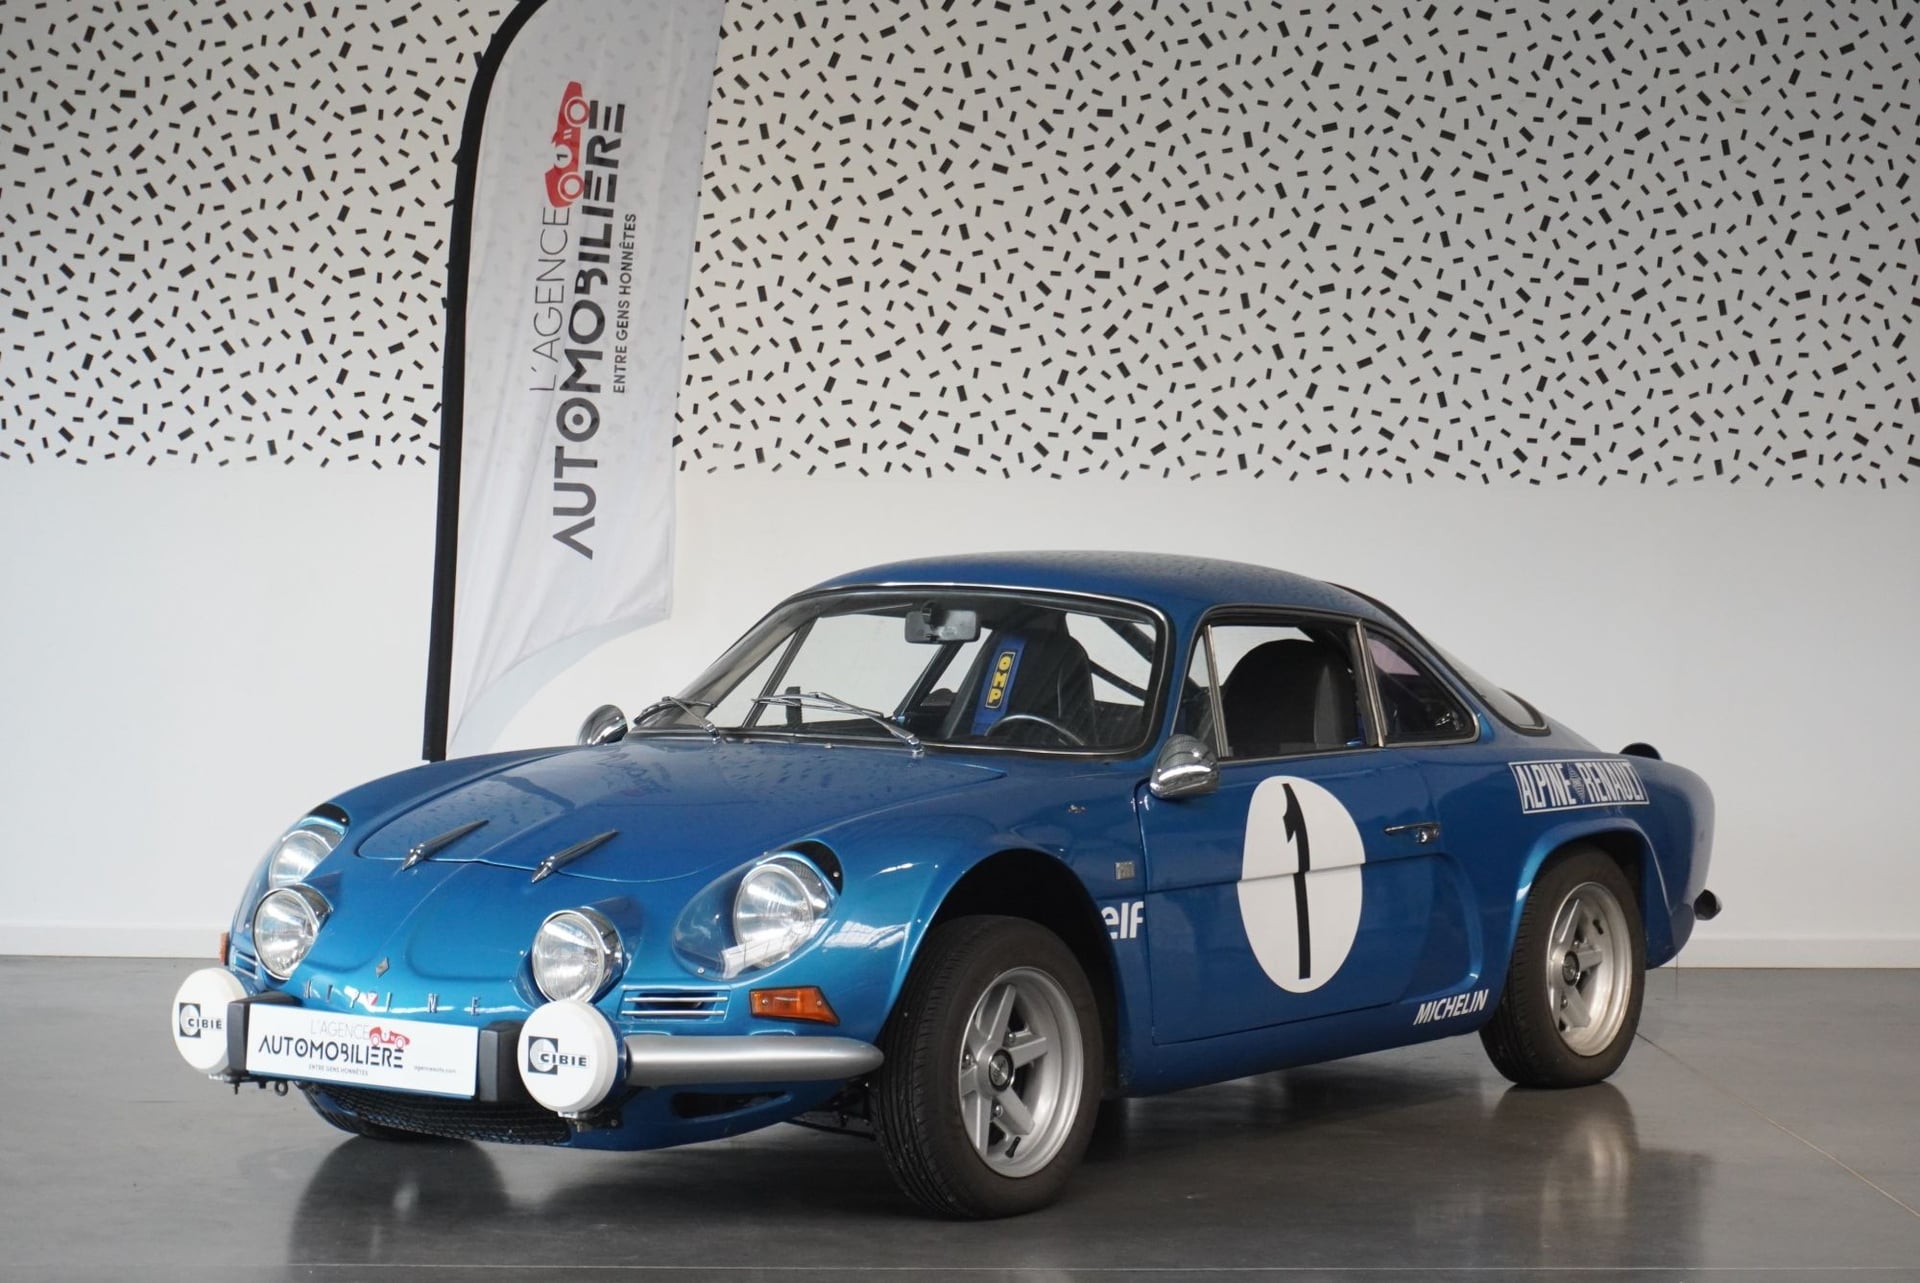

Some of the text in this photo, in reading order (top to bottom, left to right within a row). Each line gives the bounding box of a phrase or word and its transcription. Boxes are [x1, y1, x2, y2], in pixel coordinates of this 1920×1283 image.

[529, 207, 570, 391] L'AGENCE
[613, 213, 637, 393] ENTRE GENS HONNÊTES
[988, 655, 1011, 703] OMP
[1515, 761, 1645, 809] ALPINE RENAULT
[1281, 783, 1311, 980] 1
[1101, 901, 1144, 939] elf
[310, 1018, 370, 1040] L'AGENCE
[1412, 988, 1489, 1026] MICHELIN
